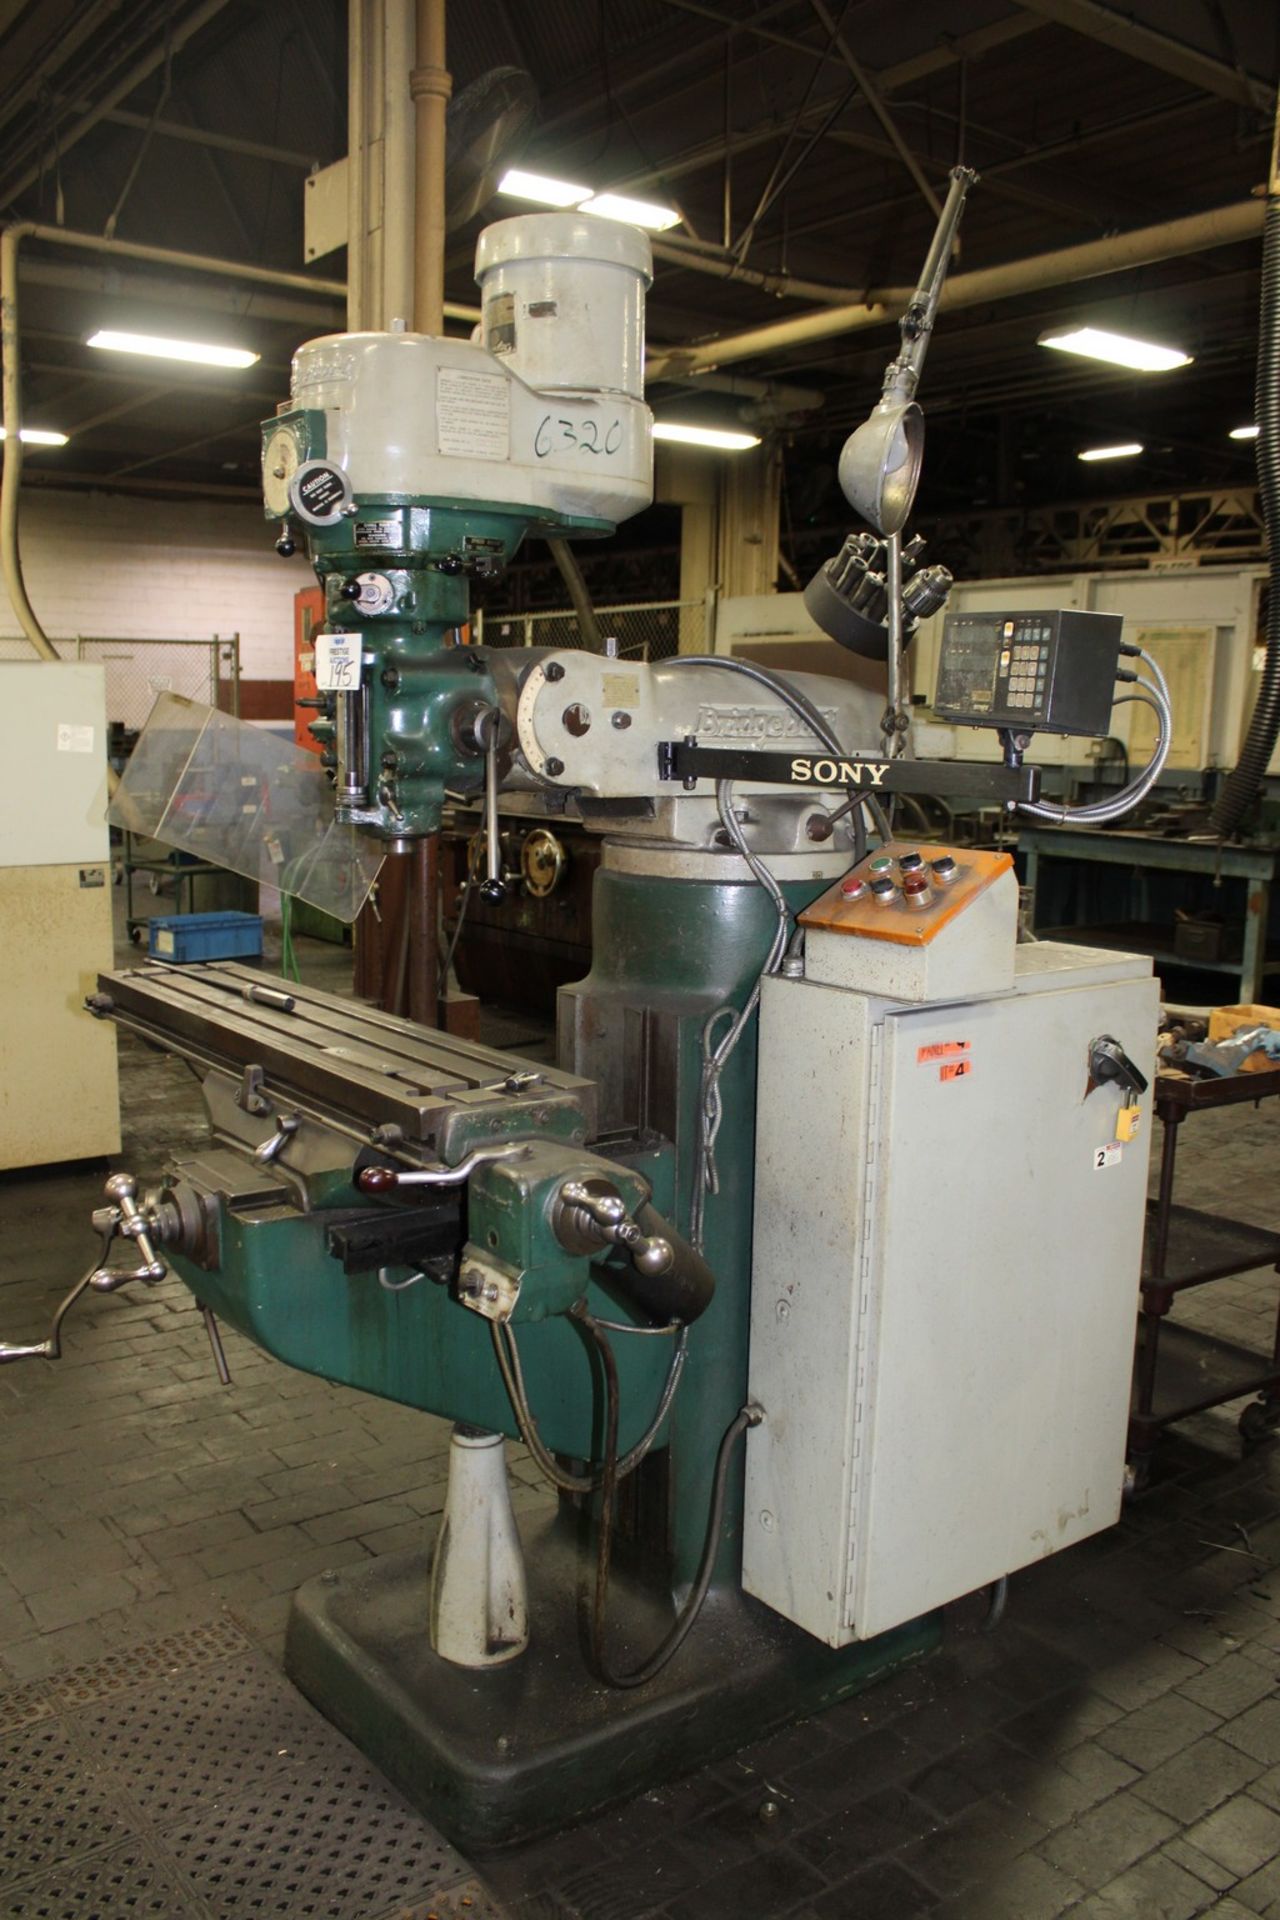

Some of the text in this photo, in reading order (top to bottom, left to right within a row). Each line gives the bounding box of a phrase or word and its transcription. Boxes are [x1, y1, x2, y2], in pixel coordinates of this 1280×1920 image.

[534, 415, 624, 458] 6320
[302, 471, 330, 492] CAUTION
[329, 660, 354, 688] 195
[791, 759, 890, 786] SONY
[1097, 1151, 1105, 1167] 2
